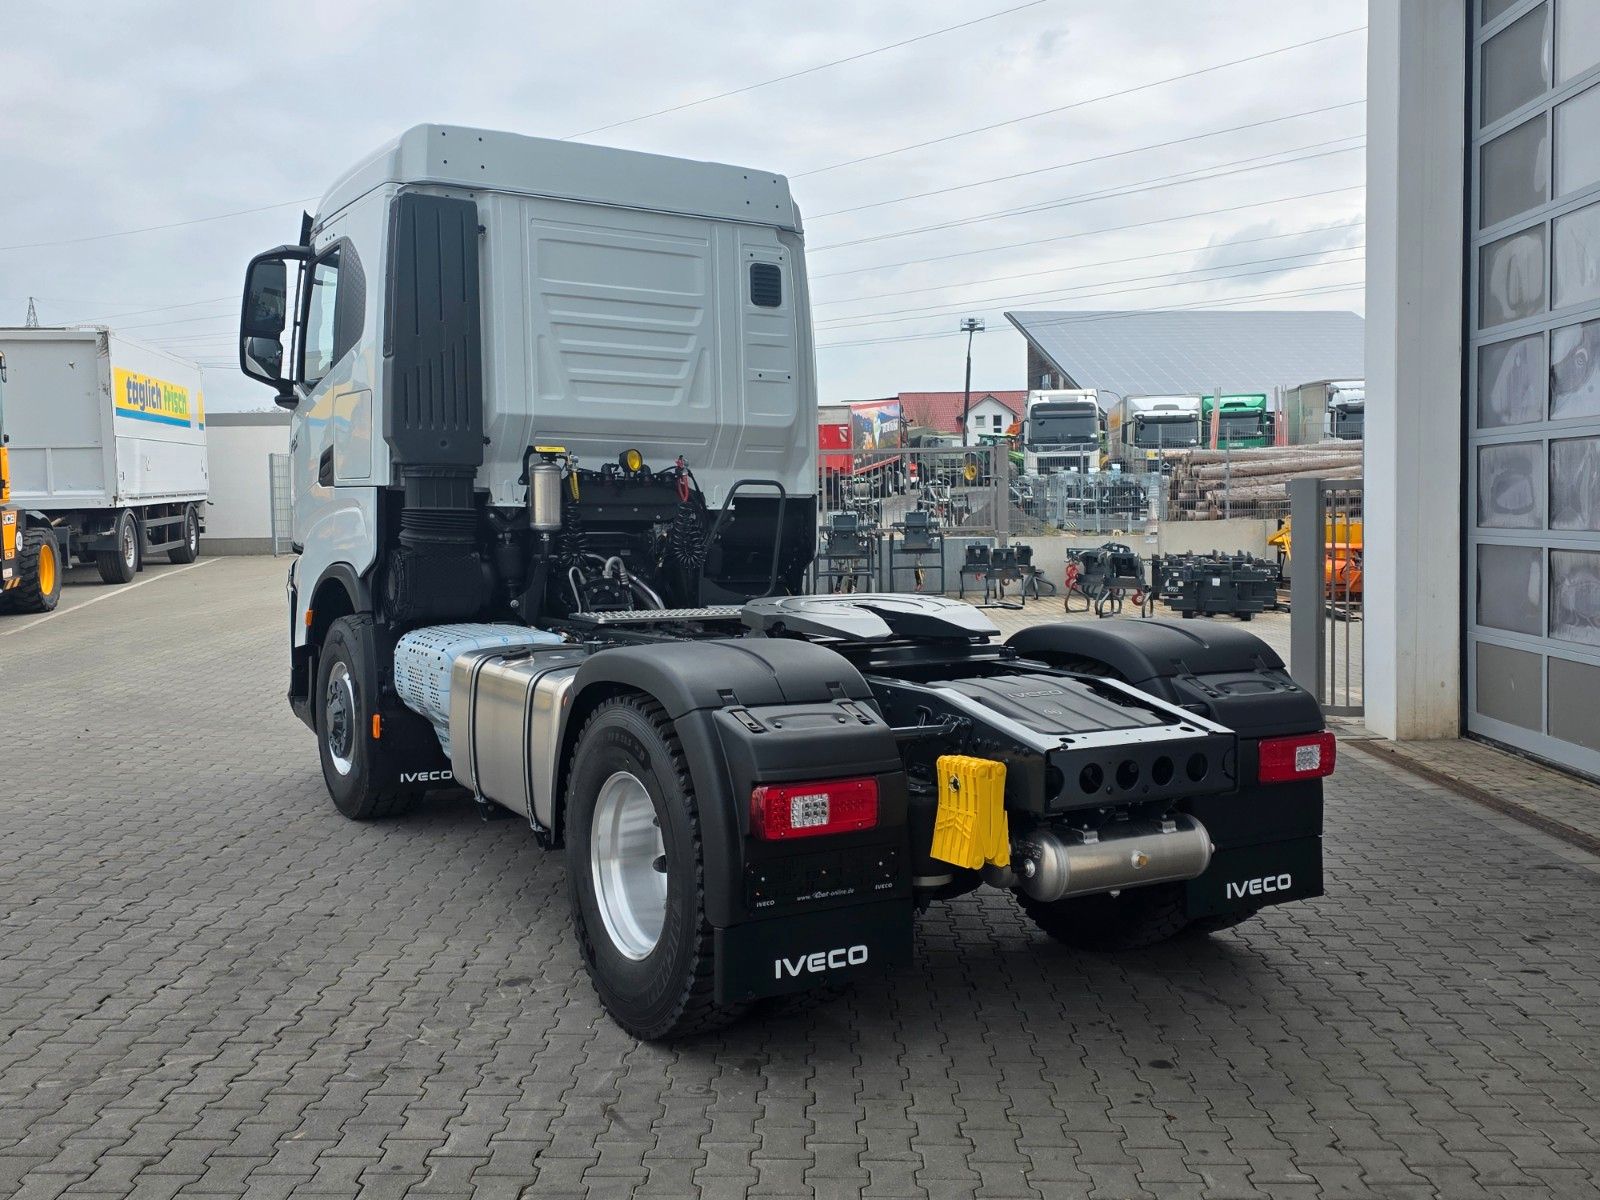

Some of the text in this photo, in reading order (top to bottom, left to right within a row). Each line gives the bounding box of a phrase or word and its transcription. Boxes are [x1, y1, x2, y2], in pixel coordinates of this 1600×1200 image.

[126, 374, 187, 414] täglich frisch
[1007, 689, 1064, 699] IVECO
[400, 770, 453, 783] IVECO
[875, 882, 893, 890] IVECO
[1226, 873, 1292, 899] IVECO
[756, 899, 775, 908] IVECO
[774, 945, 868, 979] IVECO
